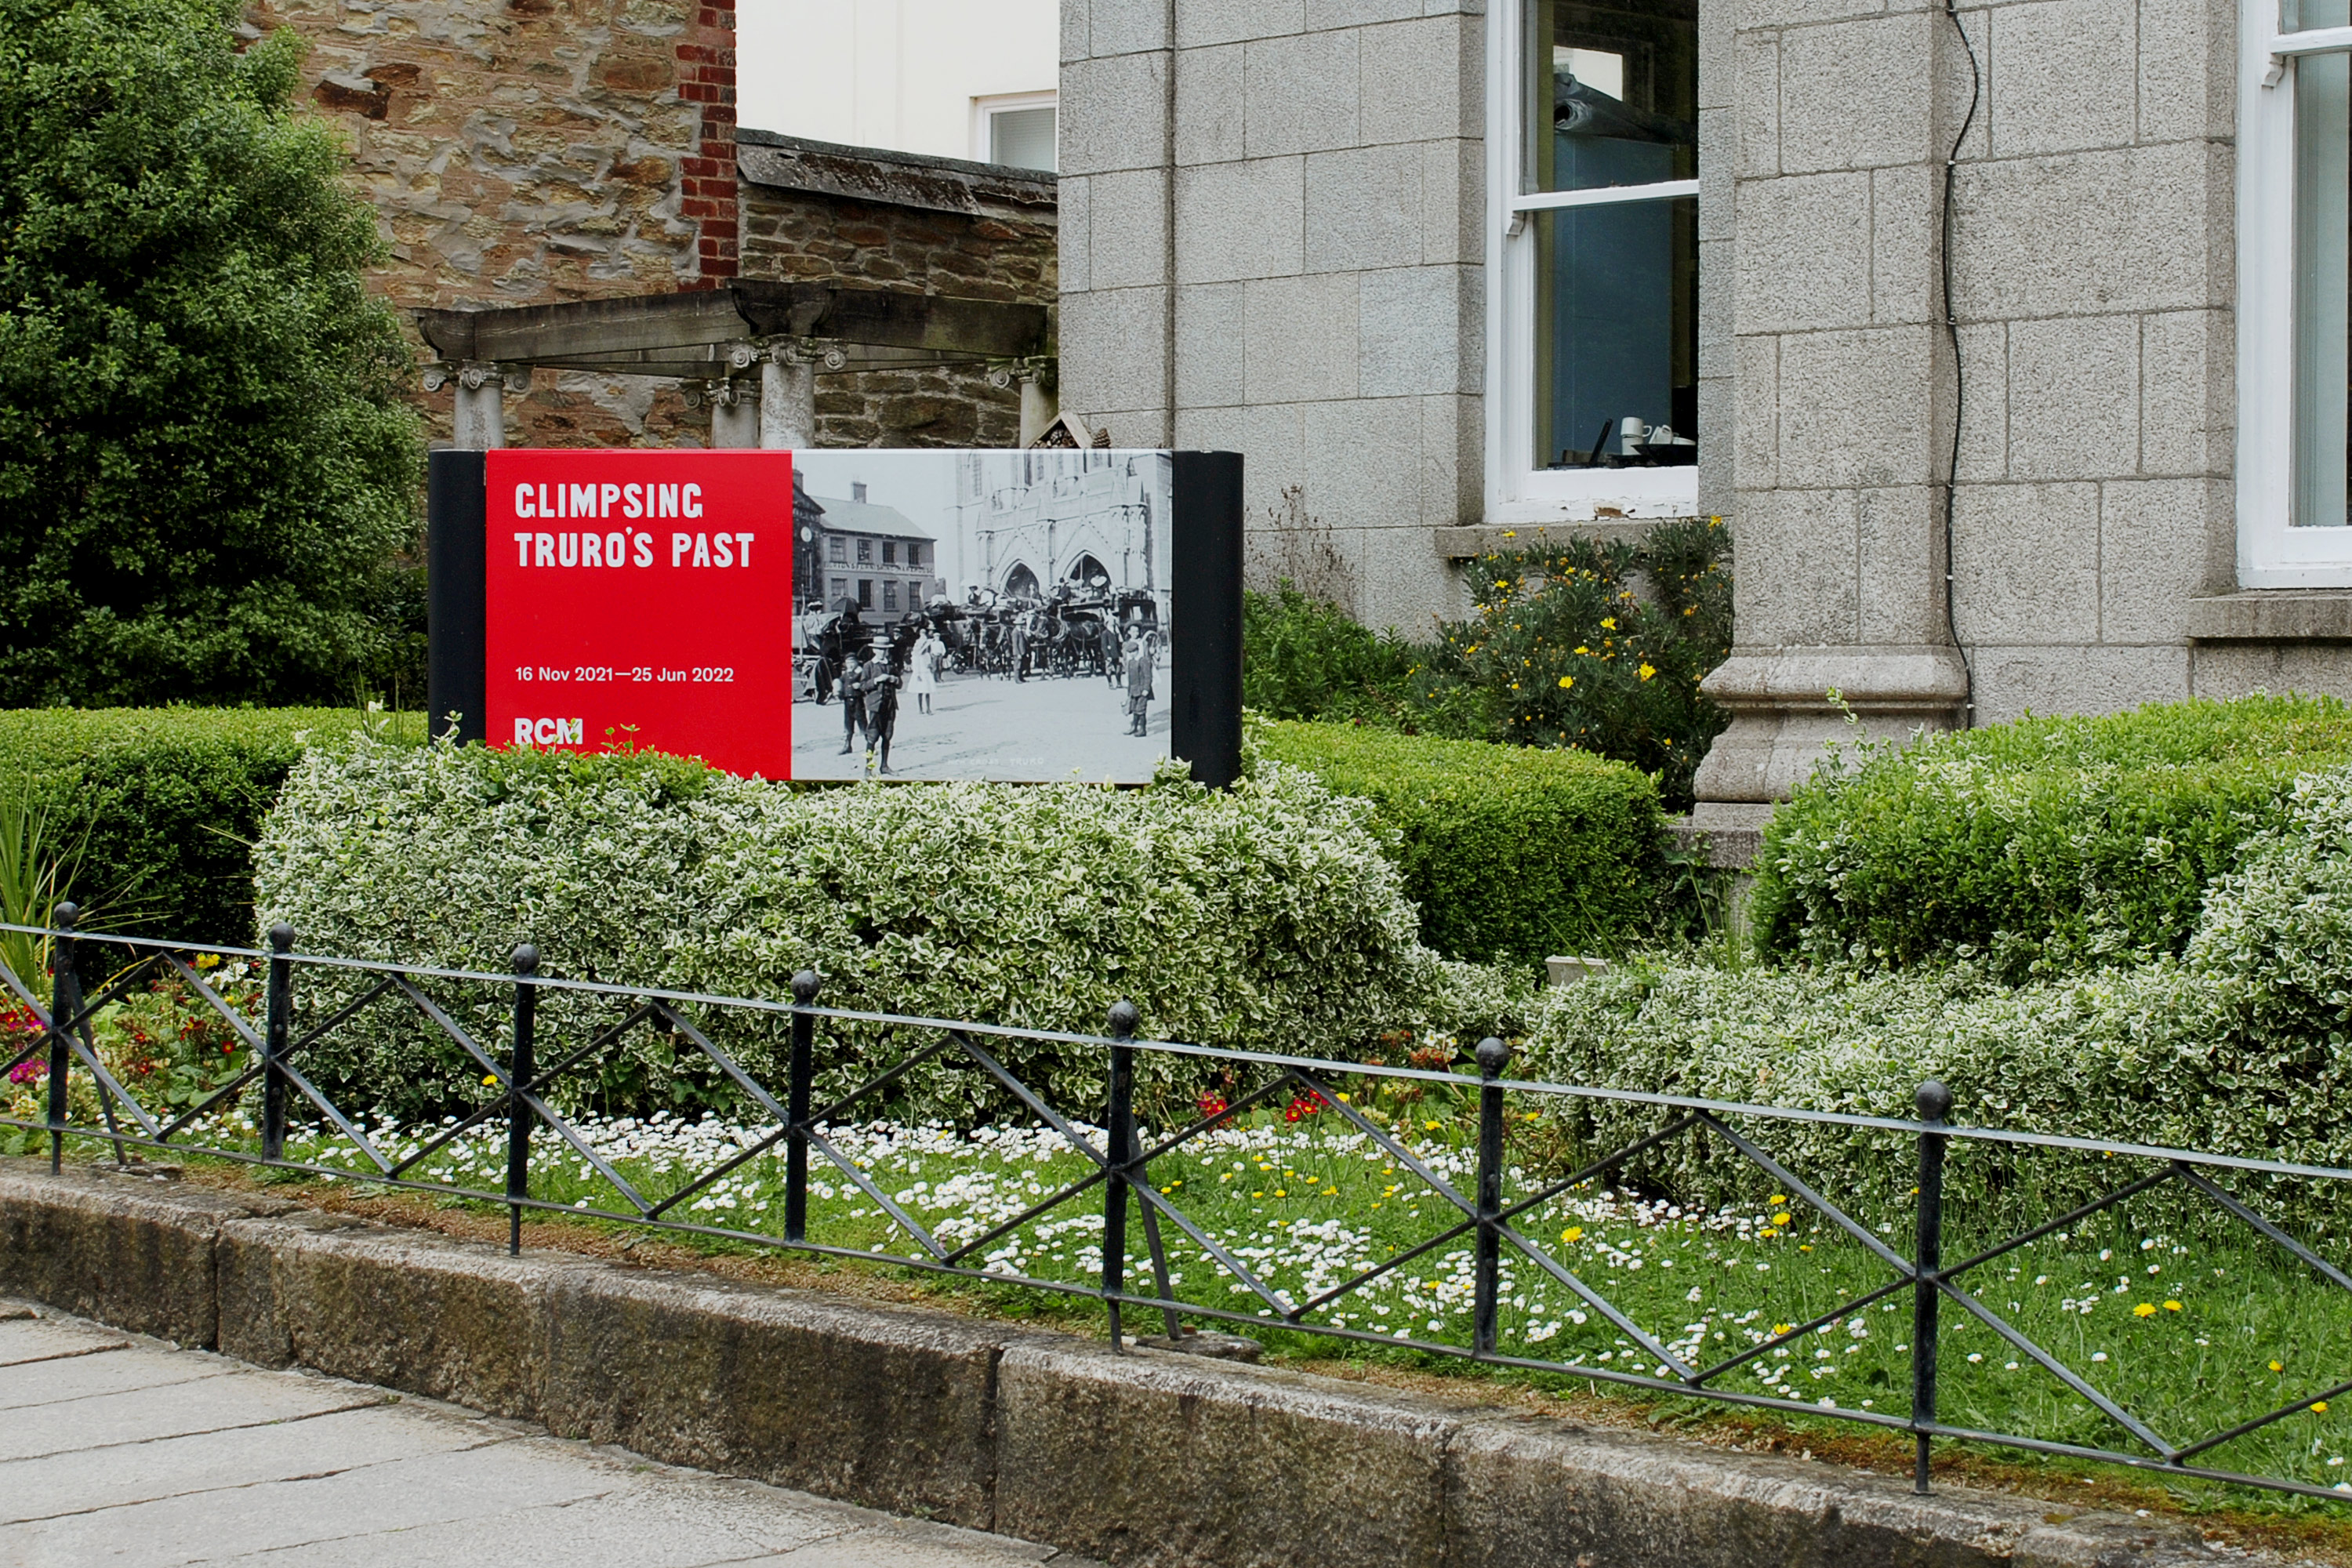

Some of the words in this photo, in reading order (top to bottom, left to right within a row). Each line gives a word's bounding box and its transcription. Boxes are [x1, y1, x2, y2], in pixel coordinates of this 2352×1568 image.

[515, 483, 702, 518] GLIMPSING
[514, 526, 654, 568] TRURO’S
[672, 532, 755, 568] PAST
[515, 666, 533, 681] 16
[539, 666, 570, 681] Nov
[657, 667, 687, 682] Jun
[691, 667, 735, 682] 2022
[514, 717, 583, 745] RCM
